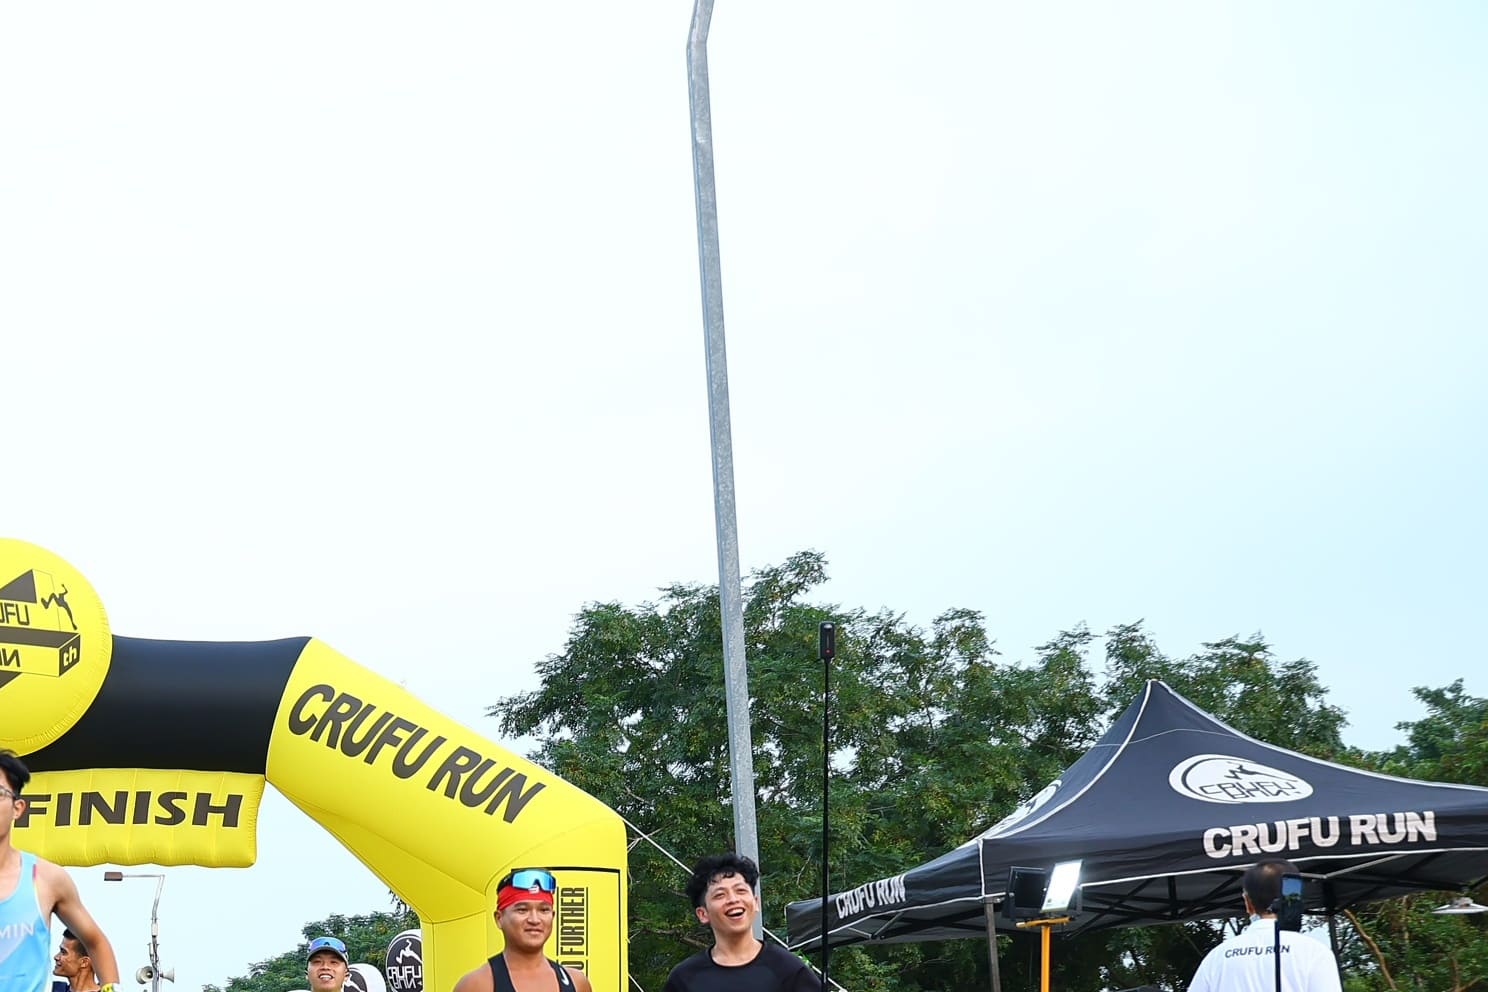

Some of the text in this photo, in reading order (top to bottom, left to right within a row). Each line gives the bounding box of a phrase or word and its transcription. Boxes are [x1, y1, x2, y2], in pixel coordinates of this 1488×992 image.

[288, 684, 546, 824] CRUFU RUN
[11, 790, 244, 828] FINISH
[1203, 811, 1437, 858] CRUFU RUN
[836, 874, 906, 919] CRUFU RUN
[561, 887, 585, 956] FURTHER
[1225, 946, 1263, 958] CRUFU
